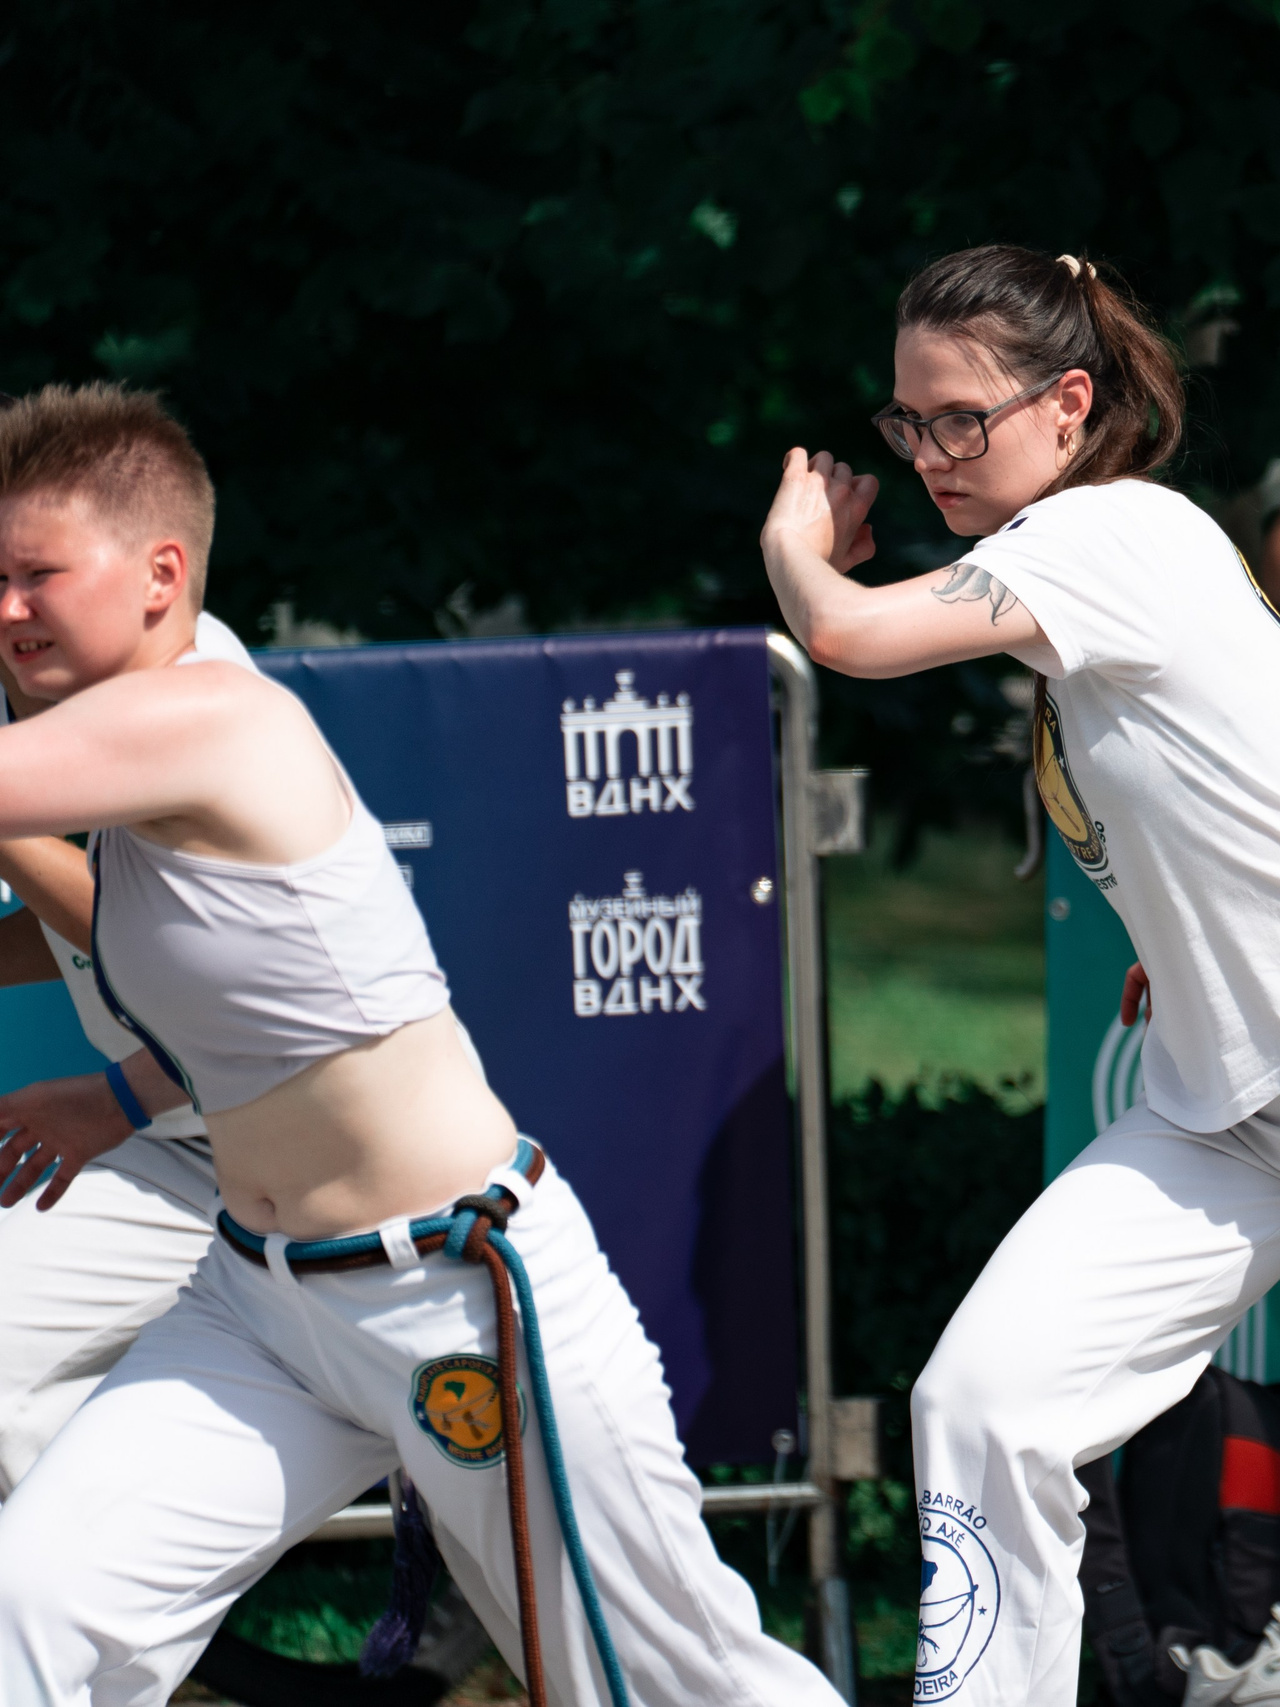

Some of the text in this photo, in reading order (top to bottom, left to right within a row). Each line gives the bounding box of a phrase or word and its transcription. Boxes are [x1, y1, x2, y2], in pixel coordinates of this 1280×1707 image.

[567, 776, 696, 817] ВДНХ
[570, 915, 704, 979] ГОРОД
[573, 975, 708, 1017] ВДНХ
[921, 1489, 988, 1530] BARRÃO
[935, 1521, 966, 1549] AXÉ
